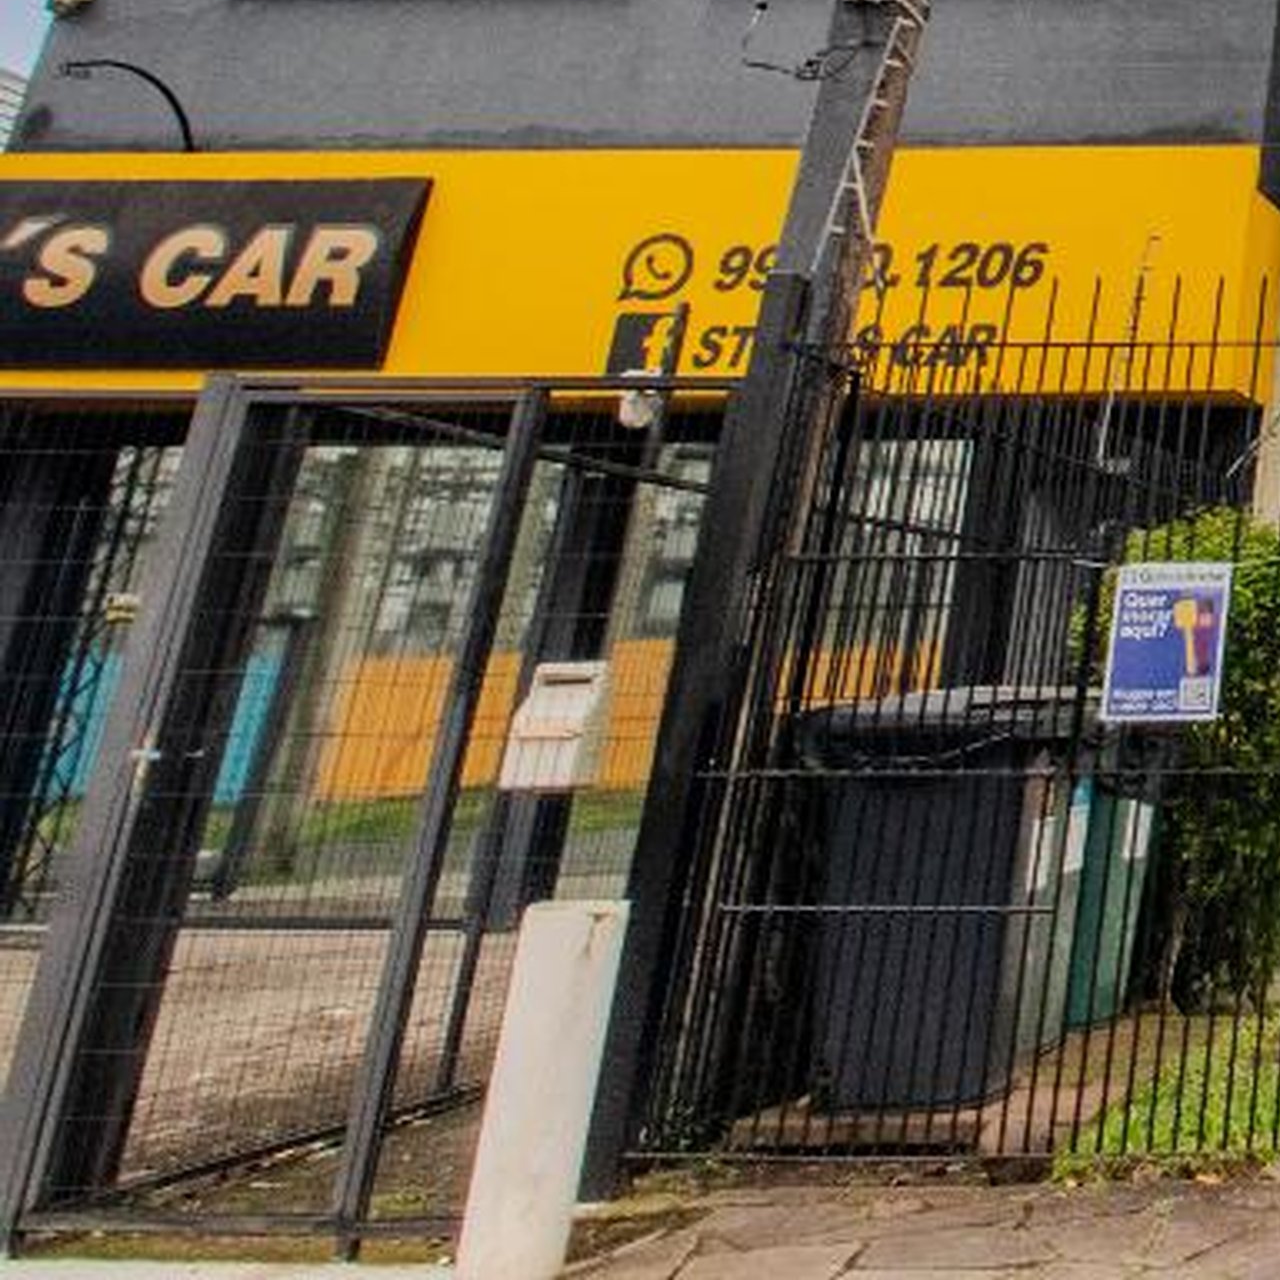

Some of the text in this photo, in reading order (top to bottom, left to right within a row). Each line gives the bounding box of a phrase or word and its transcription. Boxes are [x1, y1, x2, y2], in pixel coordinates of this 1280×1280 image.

[140, 224, 378, 308] CAR
[893, 324, 998, 368] CAR
[1123, 592, 1167, 607] Quer
